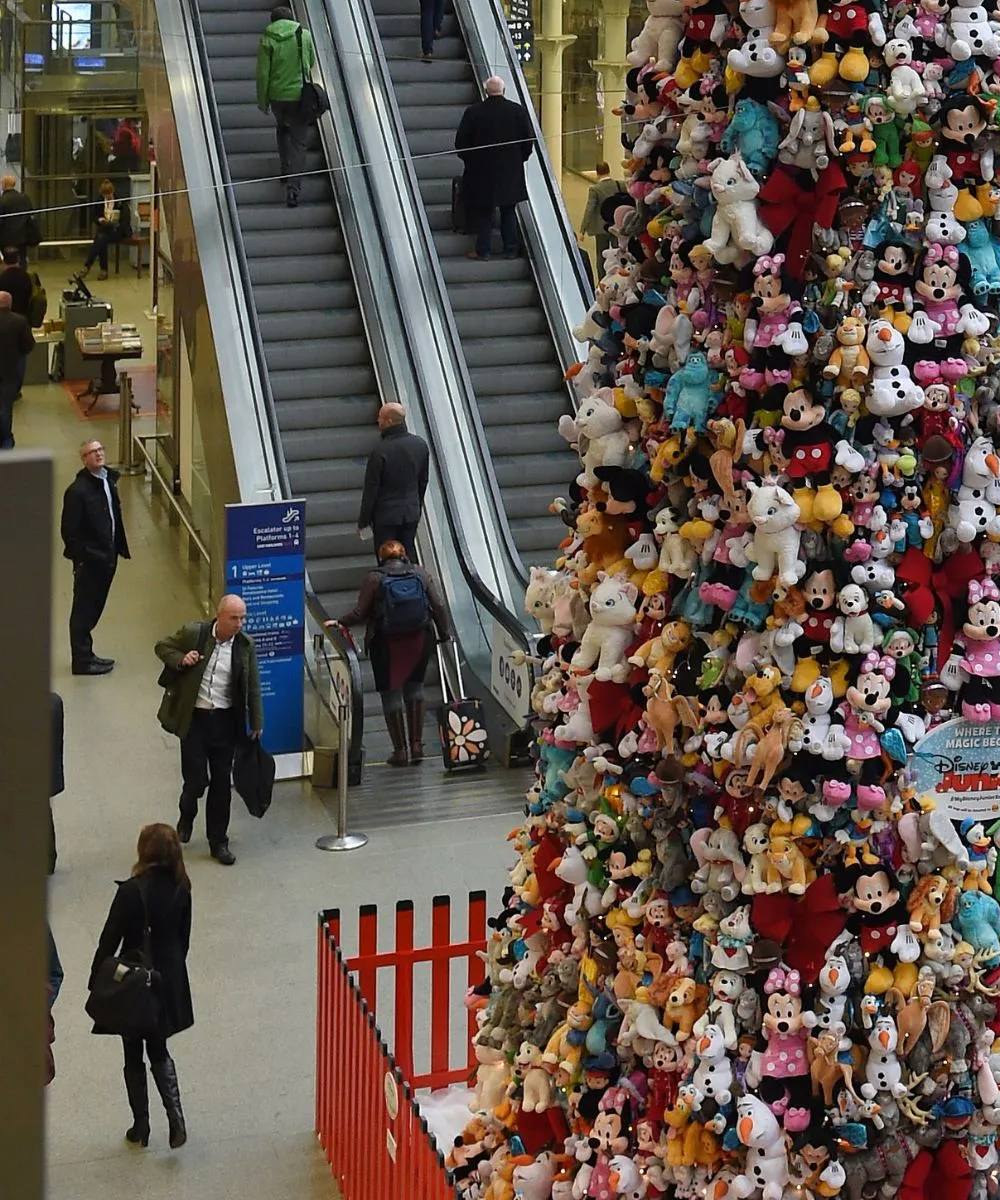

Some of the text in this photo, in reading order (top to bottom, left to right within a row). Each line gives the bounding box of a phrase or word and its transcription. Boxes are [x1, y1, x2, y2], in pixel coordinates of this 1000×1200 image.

[256, 533, 287, 542] Platforms
[232, 566, 238, 578] 1
[955, 726, 992, 738] WHERE
[945, 738, 979, 749] MAGIC
